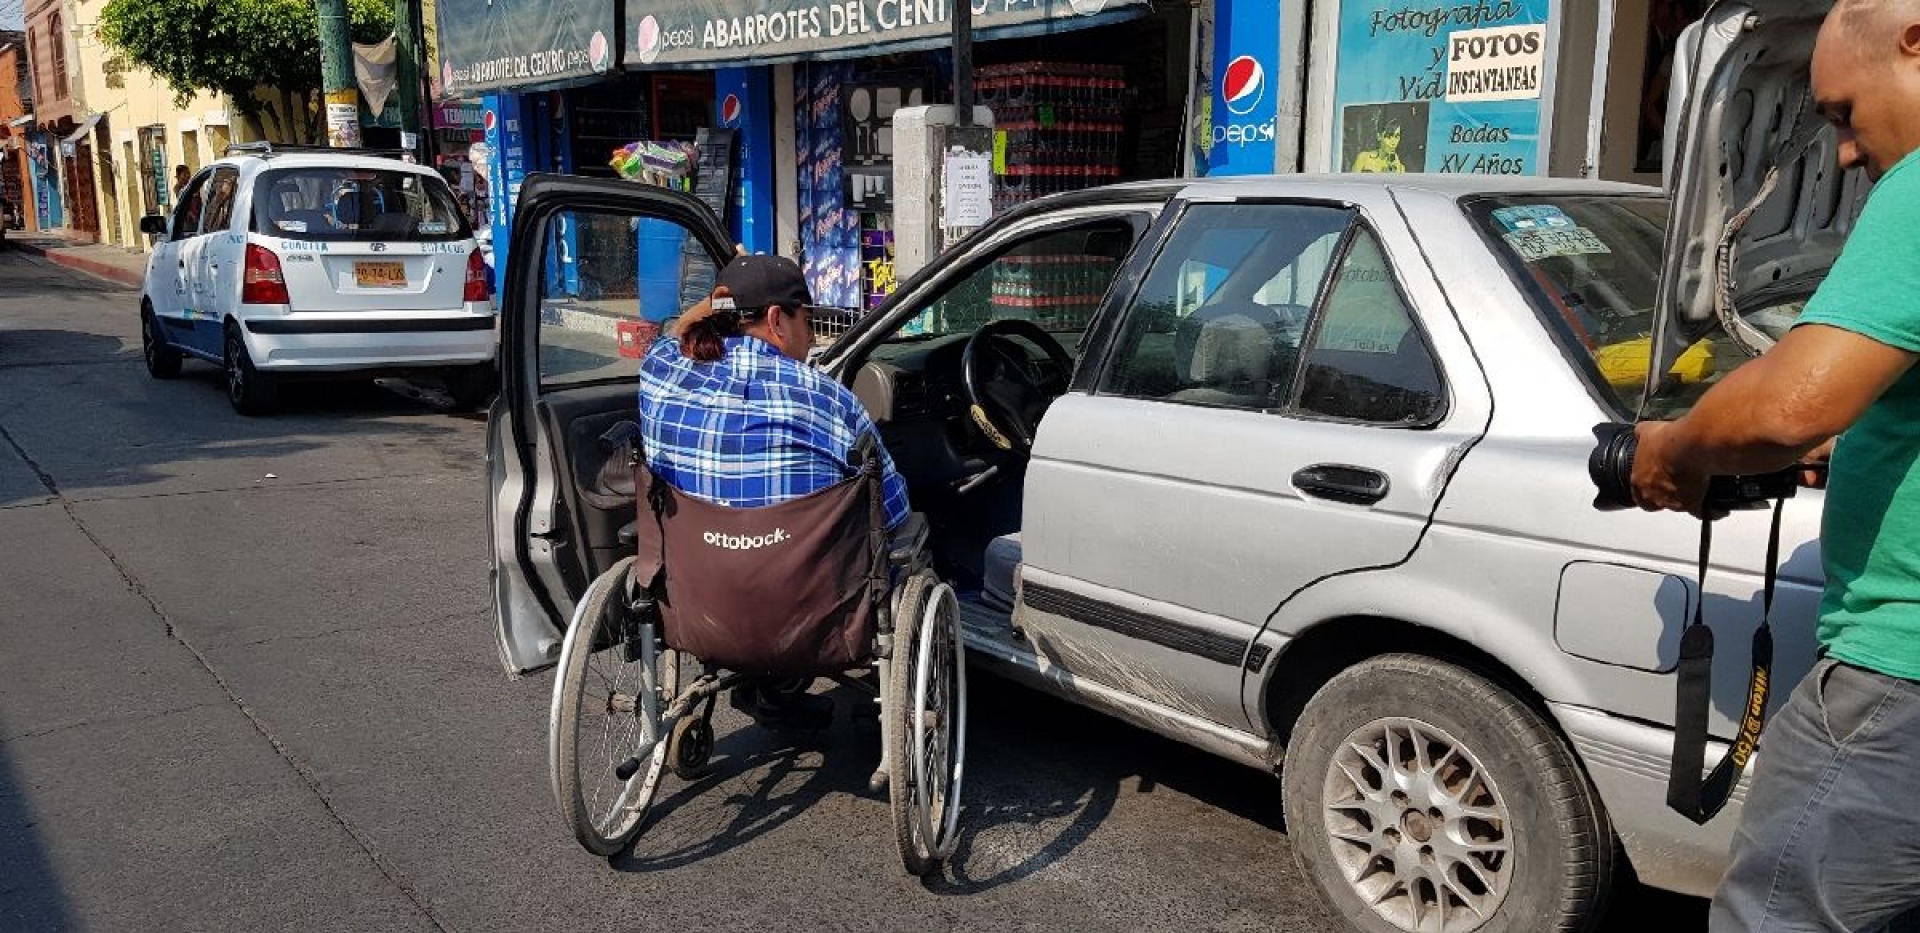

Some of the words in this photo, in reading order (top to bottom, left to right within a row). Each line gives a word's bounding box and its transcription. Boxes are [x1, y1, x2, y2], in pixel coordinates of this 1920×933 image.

[661, 25, 695, 50] pepsi
[702, 5, 820, 48] ABARROTES
[829, 1, 870, 37] DEL
[876, 0, 988, 29] CENTO
[1452, 32, 1541, 61] FOTOS
[471, 55, 513, 83] ABARROTES
[514, 54, 531, 79] DEL
[530, 49, 566, 76] CENTRO
[1211, 116, 1275, 148] pepsi
[1451, 123, 1511, 144] Bodas
[1439, 152, 1468, 174] XV
[1471, 152, 1524, 175] Años
[1751, 666, 1769, 717] Nikon
[1732, 717, 1763, 766] D750
